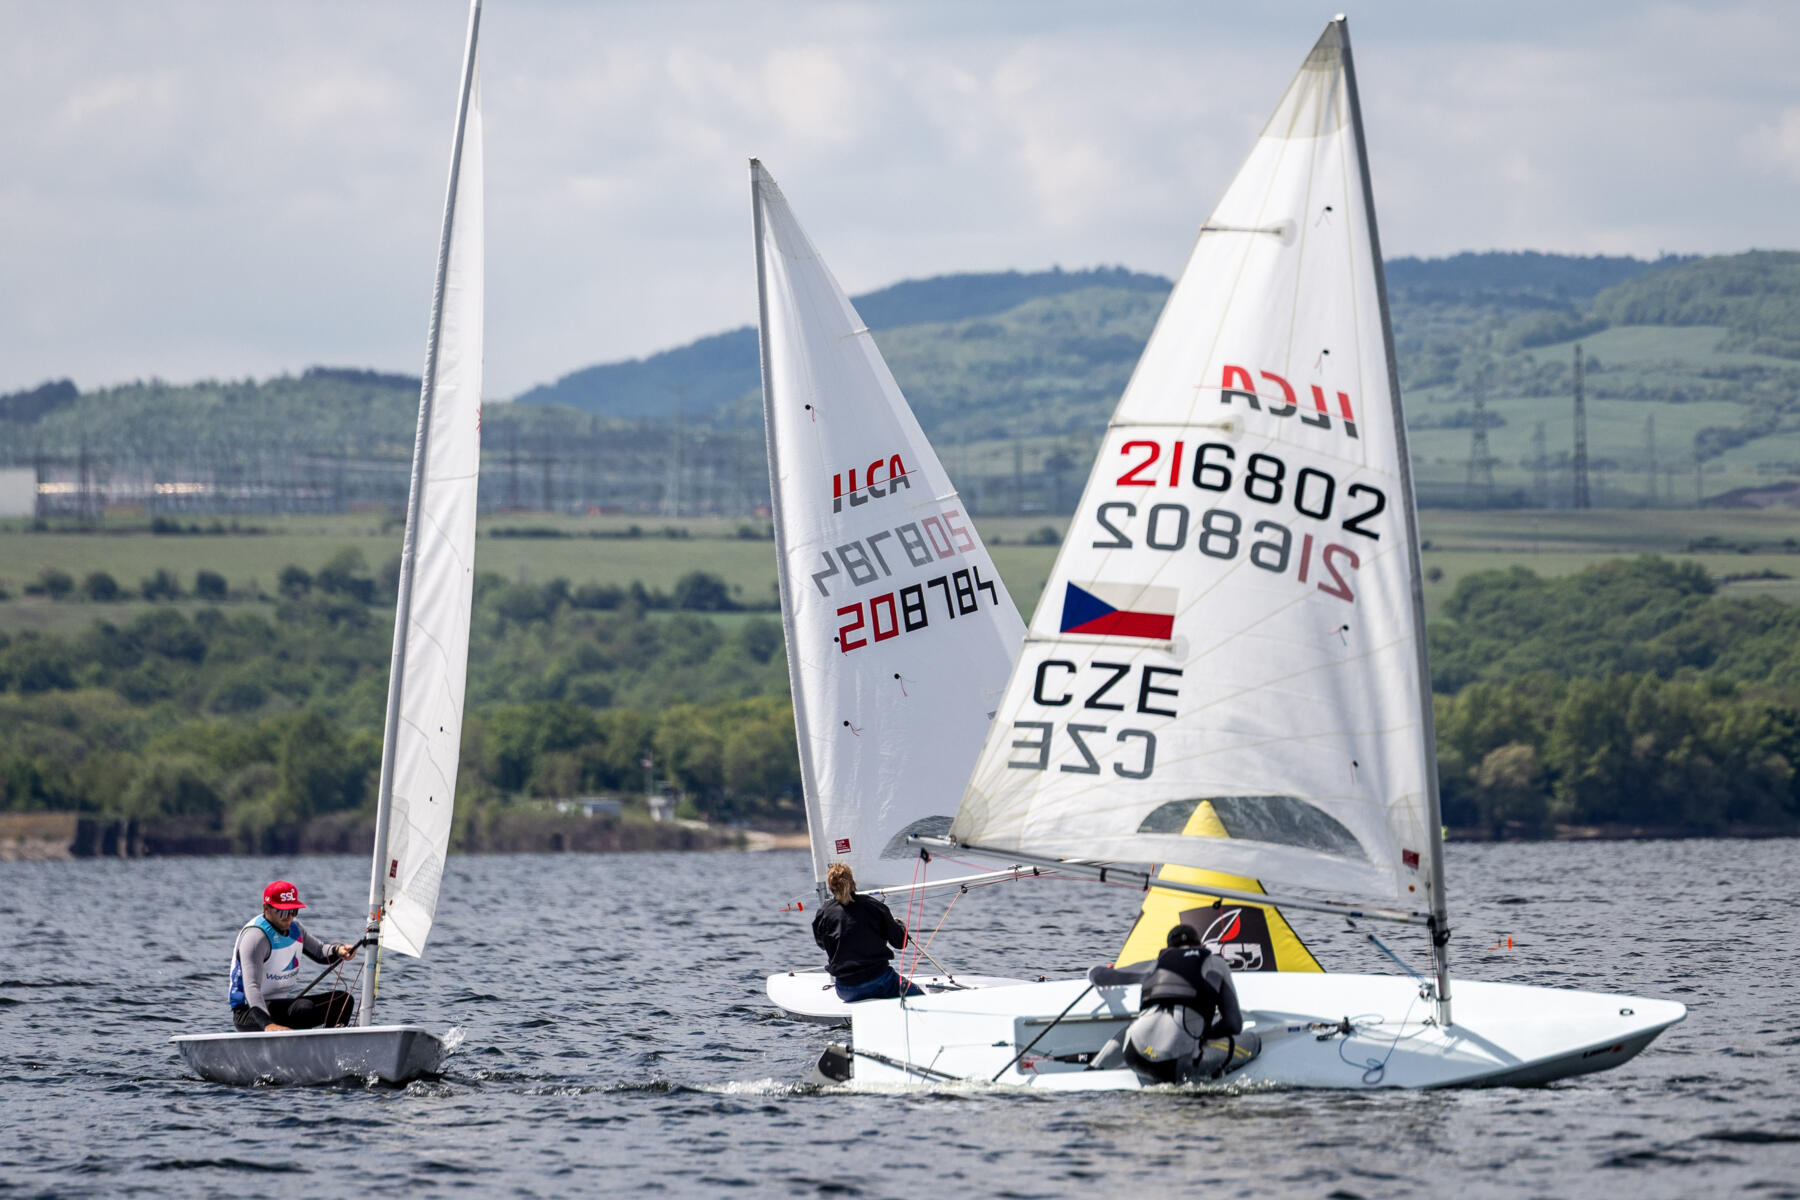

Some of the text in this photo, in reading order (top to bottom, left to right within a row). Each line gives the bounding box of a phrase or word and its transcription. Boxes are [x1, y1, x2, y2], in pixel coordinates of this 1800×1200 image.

[833, 453, 911, 514] ILCA
[1116, 440, 1386, 541] 216802
[836, 565, 999, 653] 208784
[1033, 660, 1183, 718] CZE
[280, 891, 297, 902] SSL
